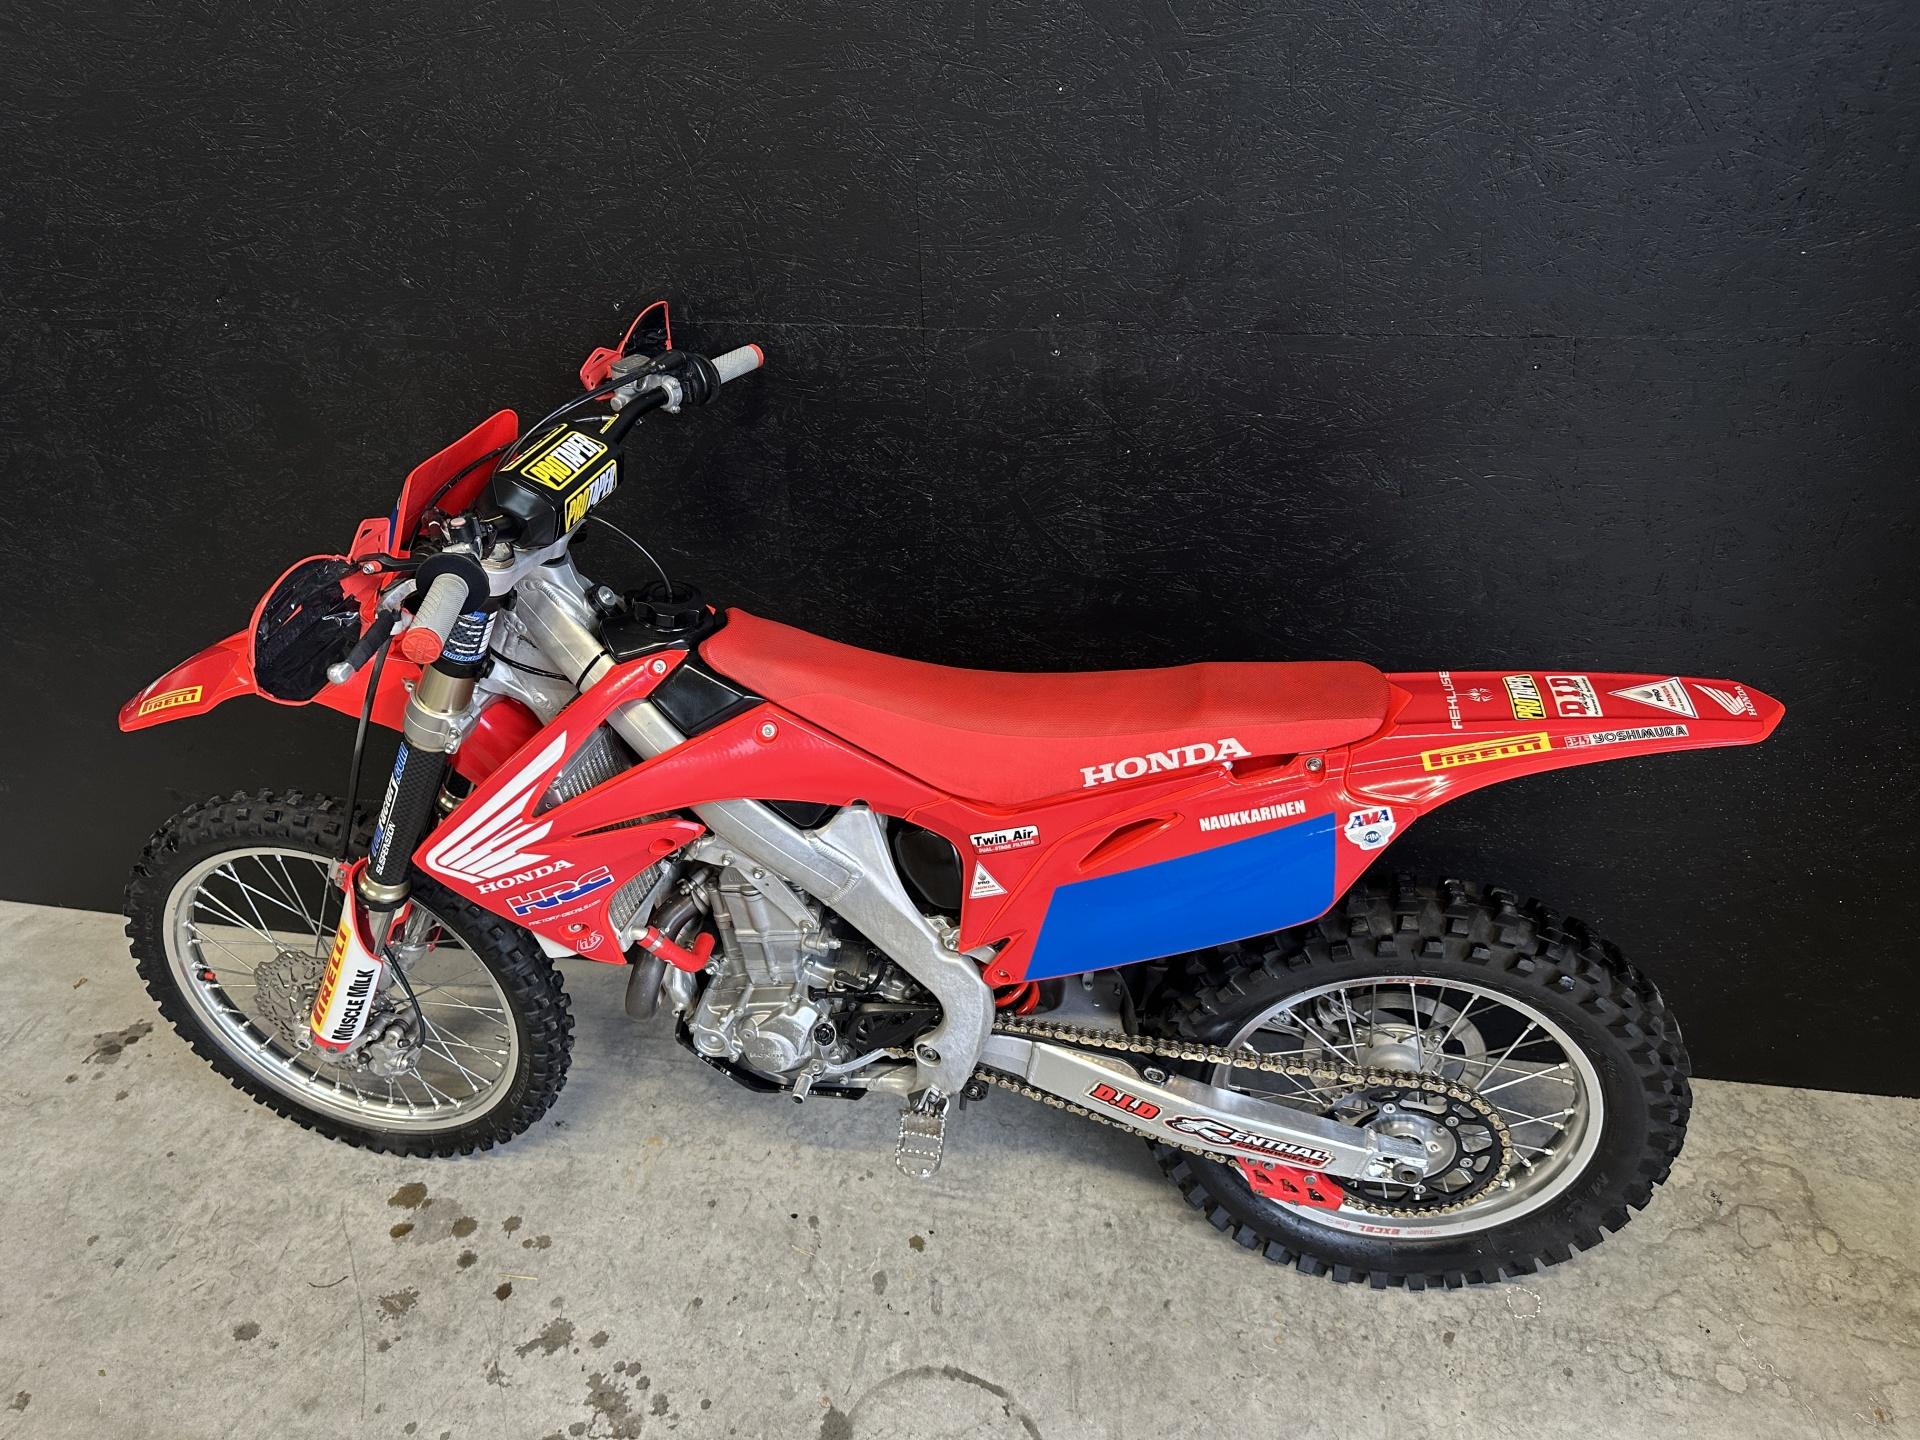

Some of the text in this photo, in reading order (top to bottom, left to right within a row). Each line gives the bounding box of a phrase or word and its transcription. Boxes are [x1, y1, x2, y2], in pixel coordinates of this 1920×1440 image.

[1735, 685, 1758, 716] HONDA
[1593, 725, 1688, 744] YOSHIMURA
[1080, 737, 1252, 788] HONDA
[1428, 736, 1542, 766] PIRELLI
[1199, 800, 1307, 832] NAUKKARINEN
[1349, 809, 1390, 829] AMA
[375, 820, 396, 876] SUSPENSION
[974, 829, 1034, 847] Twin Air
[476, 860, 575, 894] HONDA
[505, 865, 615, 917] HRC
